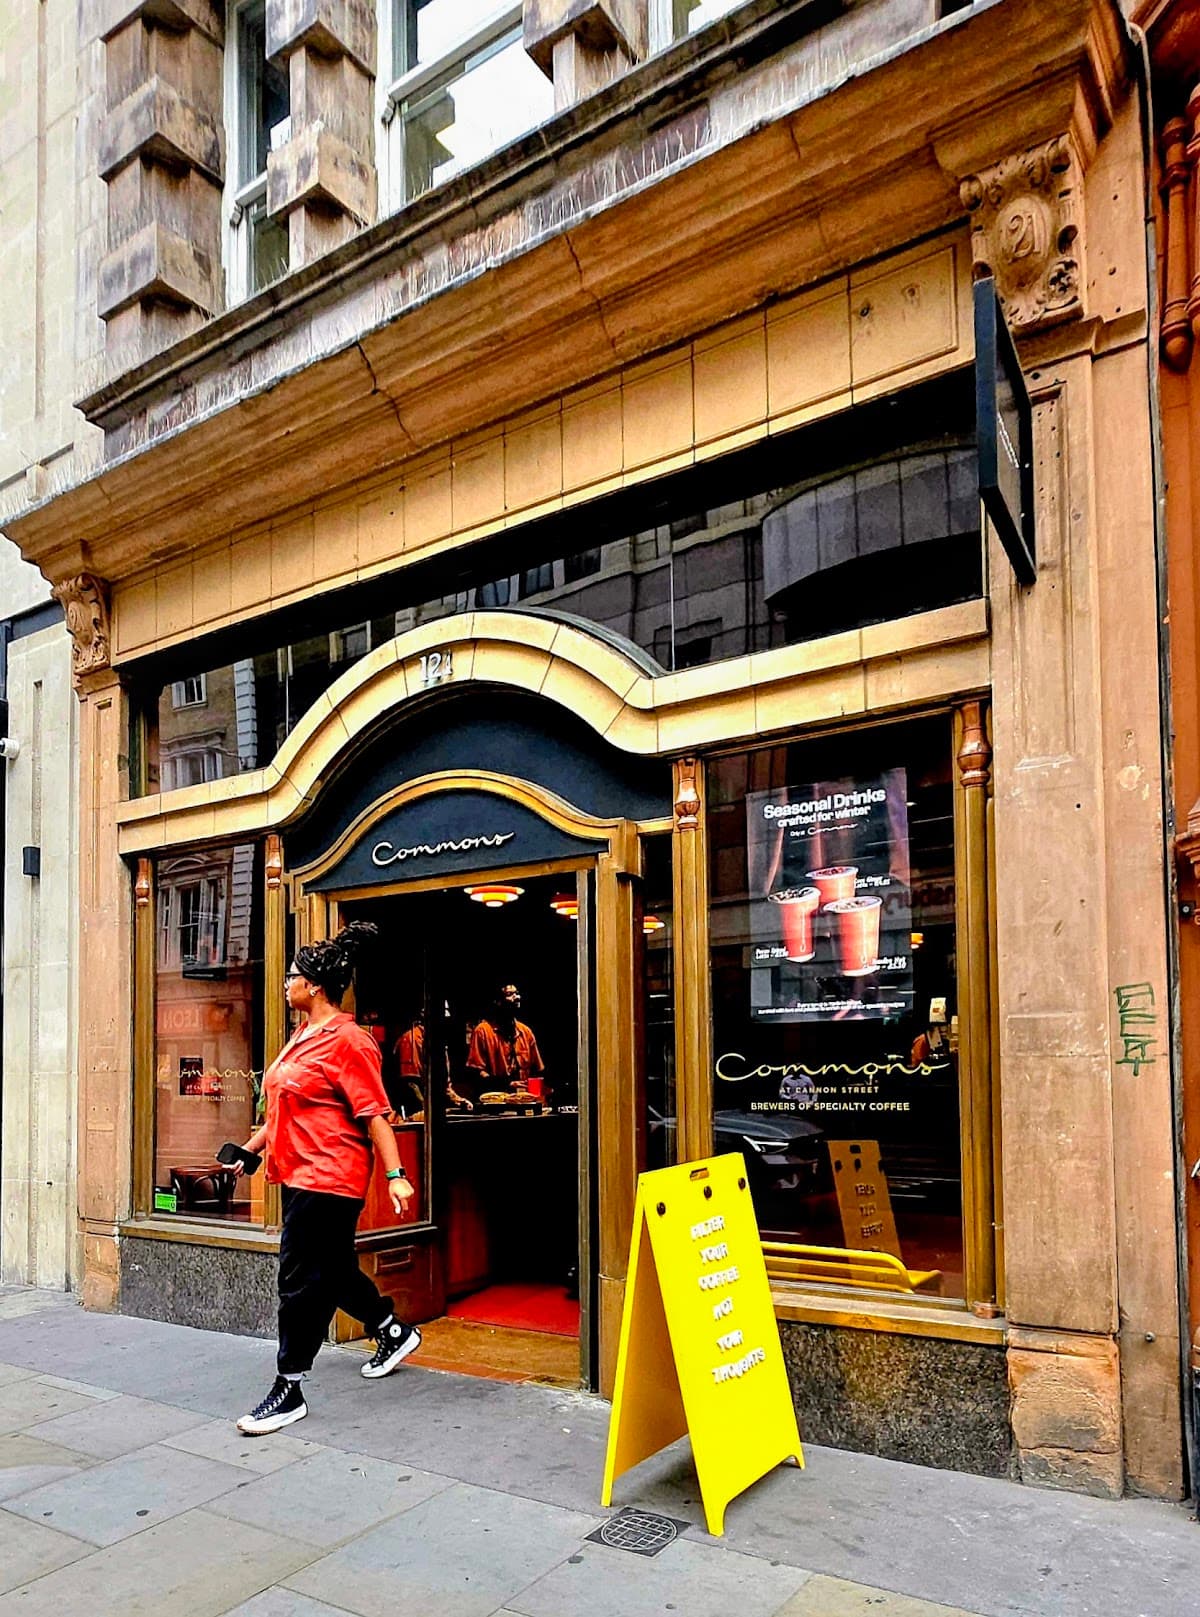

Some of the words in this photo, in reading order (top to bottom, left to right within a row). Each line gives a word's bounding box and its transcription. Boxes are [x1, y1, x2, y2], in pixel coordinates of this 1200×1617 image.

[763, 795, 831, 819] Seasonal
[834, 789, 886, 808] Drinks
[777, 813, 817, 828] crafted
[817, 811, 834, 821] for
[835, 805, 871, 819] winter
[372, 832, 514, 866] Commons
[715, 1053, 950, 1081] Commons
[779, 1086, 791, 1094] AT
[795, 1086, 837, 1094] CANNON
[841, 1086, 879, 1094] STREET
[750, 1102, 795, 1111] BREWERS
[798, 1102, 812, 1111] OF
[814, 1102, 866, 1111] SPECIALTY
[869, 1102, 910, 1111] COFFEE
[700, 1243, 728, 1264] YOUR
[699, 1266, 740, 1291] COFFEE
